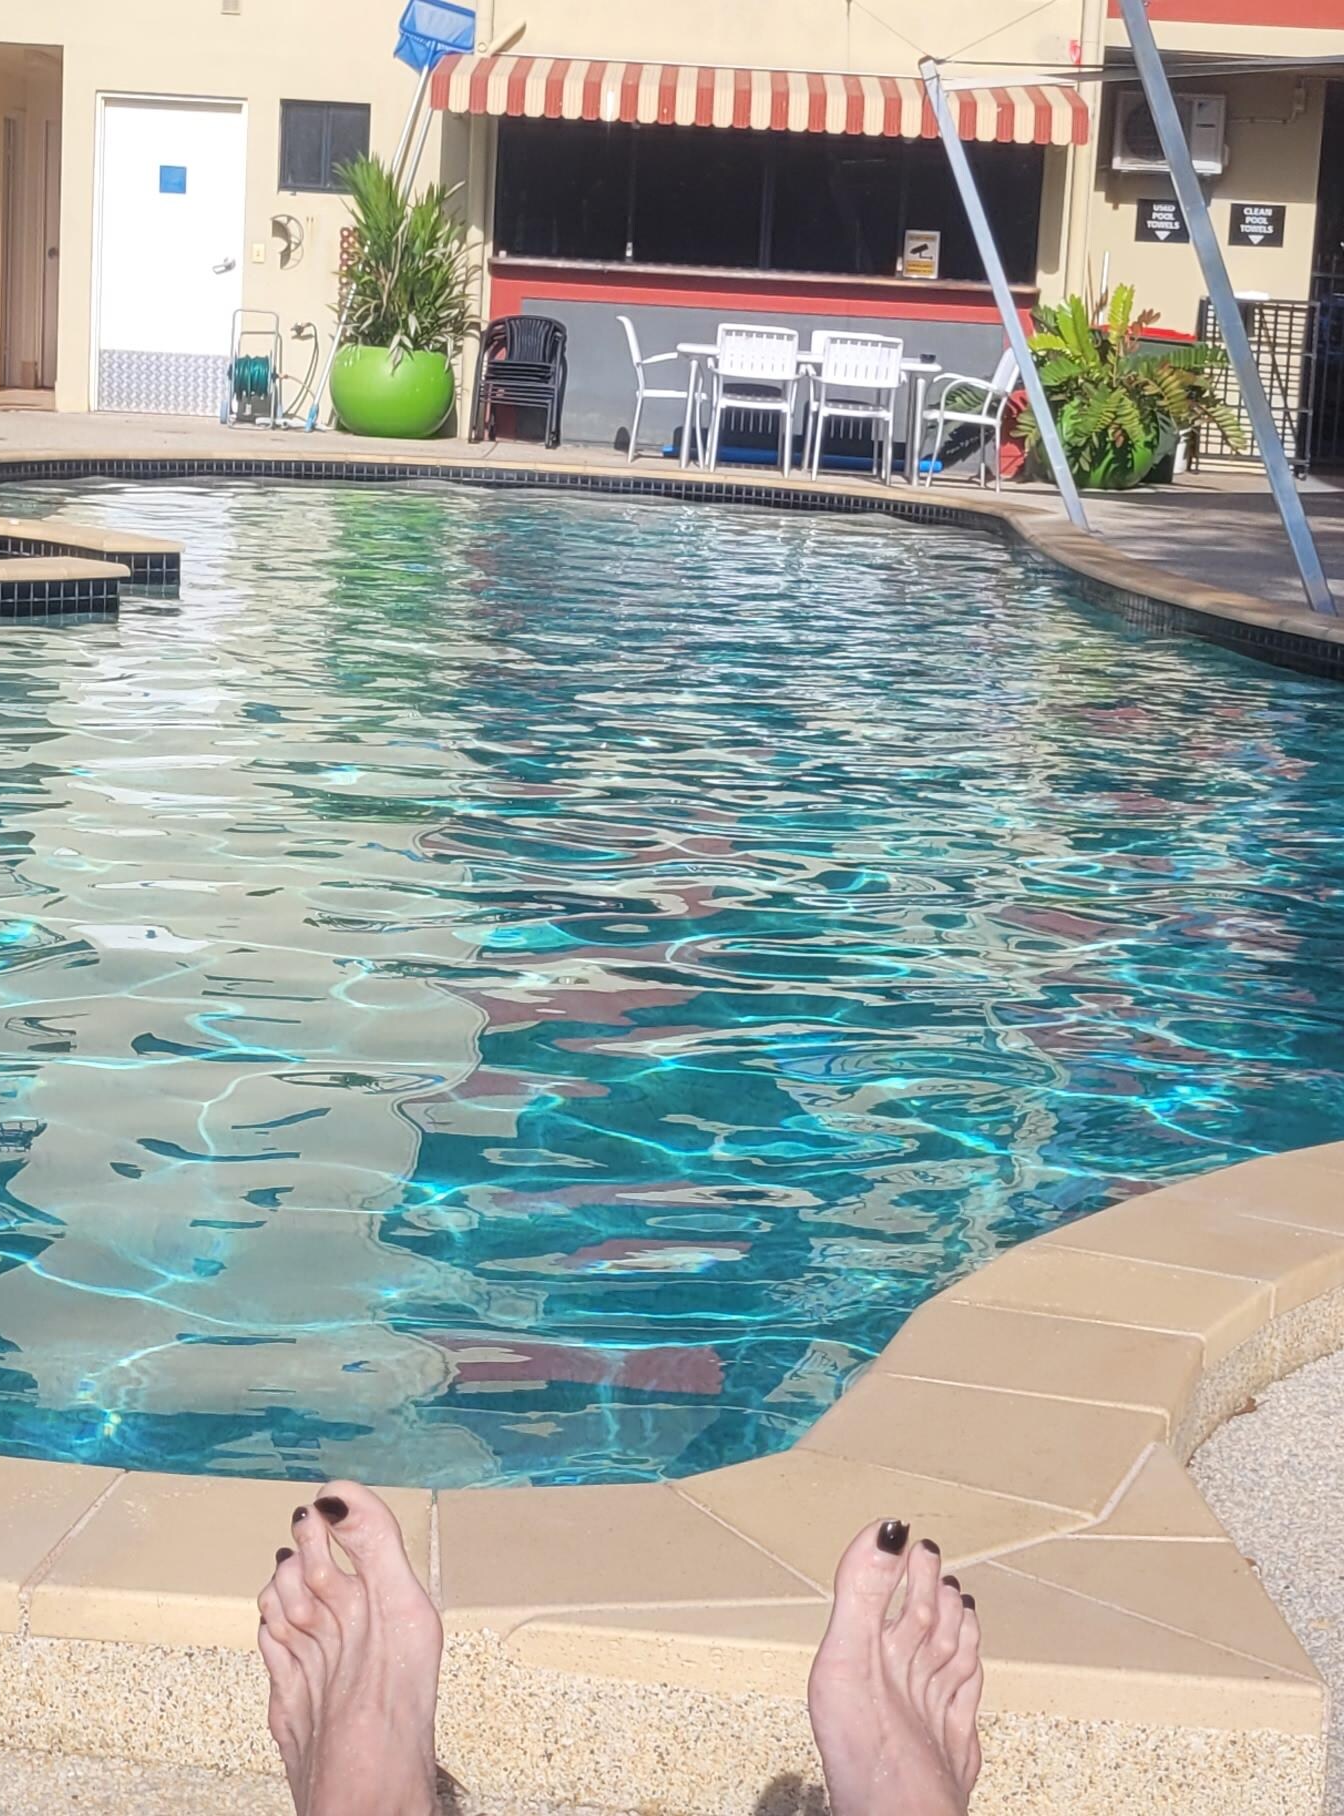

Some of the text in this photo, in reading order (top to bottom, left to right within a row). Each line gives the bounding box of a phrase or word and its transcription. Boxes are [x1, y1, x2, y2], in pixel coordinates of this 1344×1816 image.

[1152, 204, 1175, 212] USED
[1243, 207, 1273, 216] CLEAN
[1152, 212, 1175, 220] POOL
[1245, 216, 1268, 224] POOL
[1146, 220, 1180, 230] TOWELS
[1240, 224, 1274, 234] TOWELS
